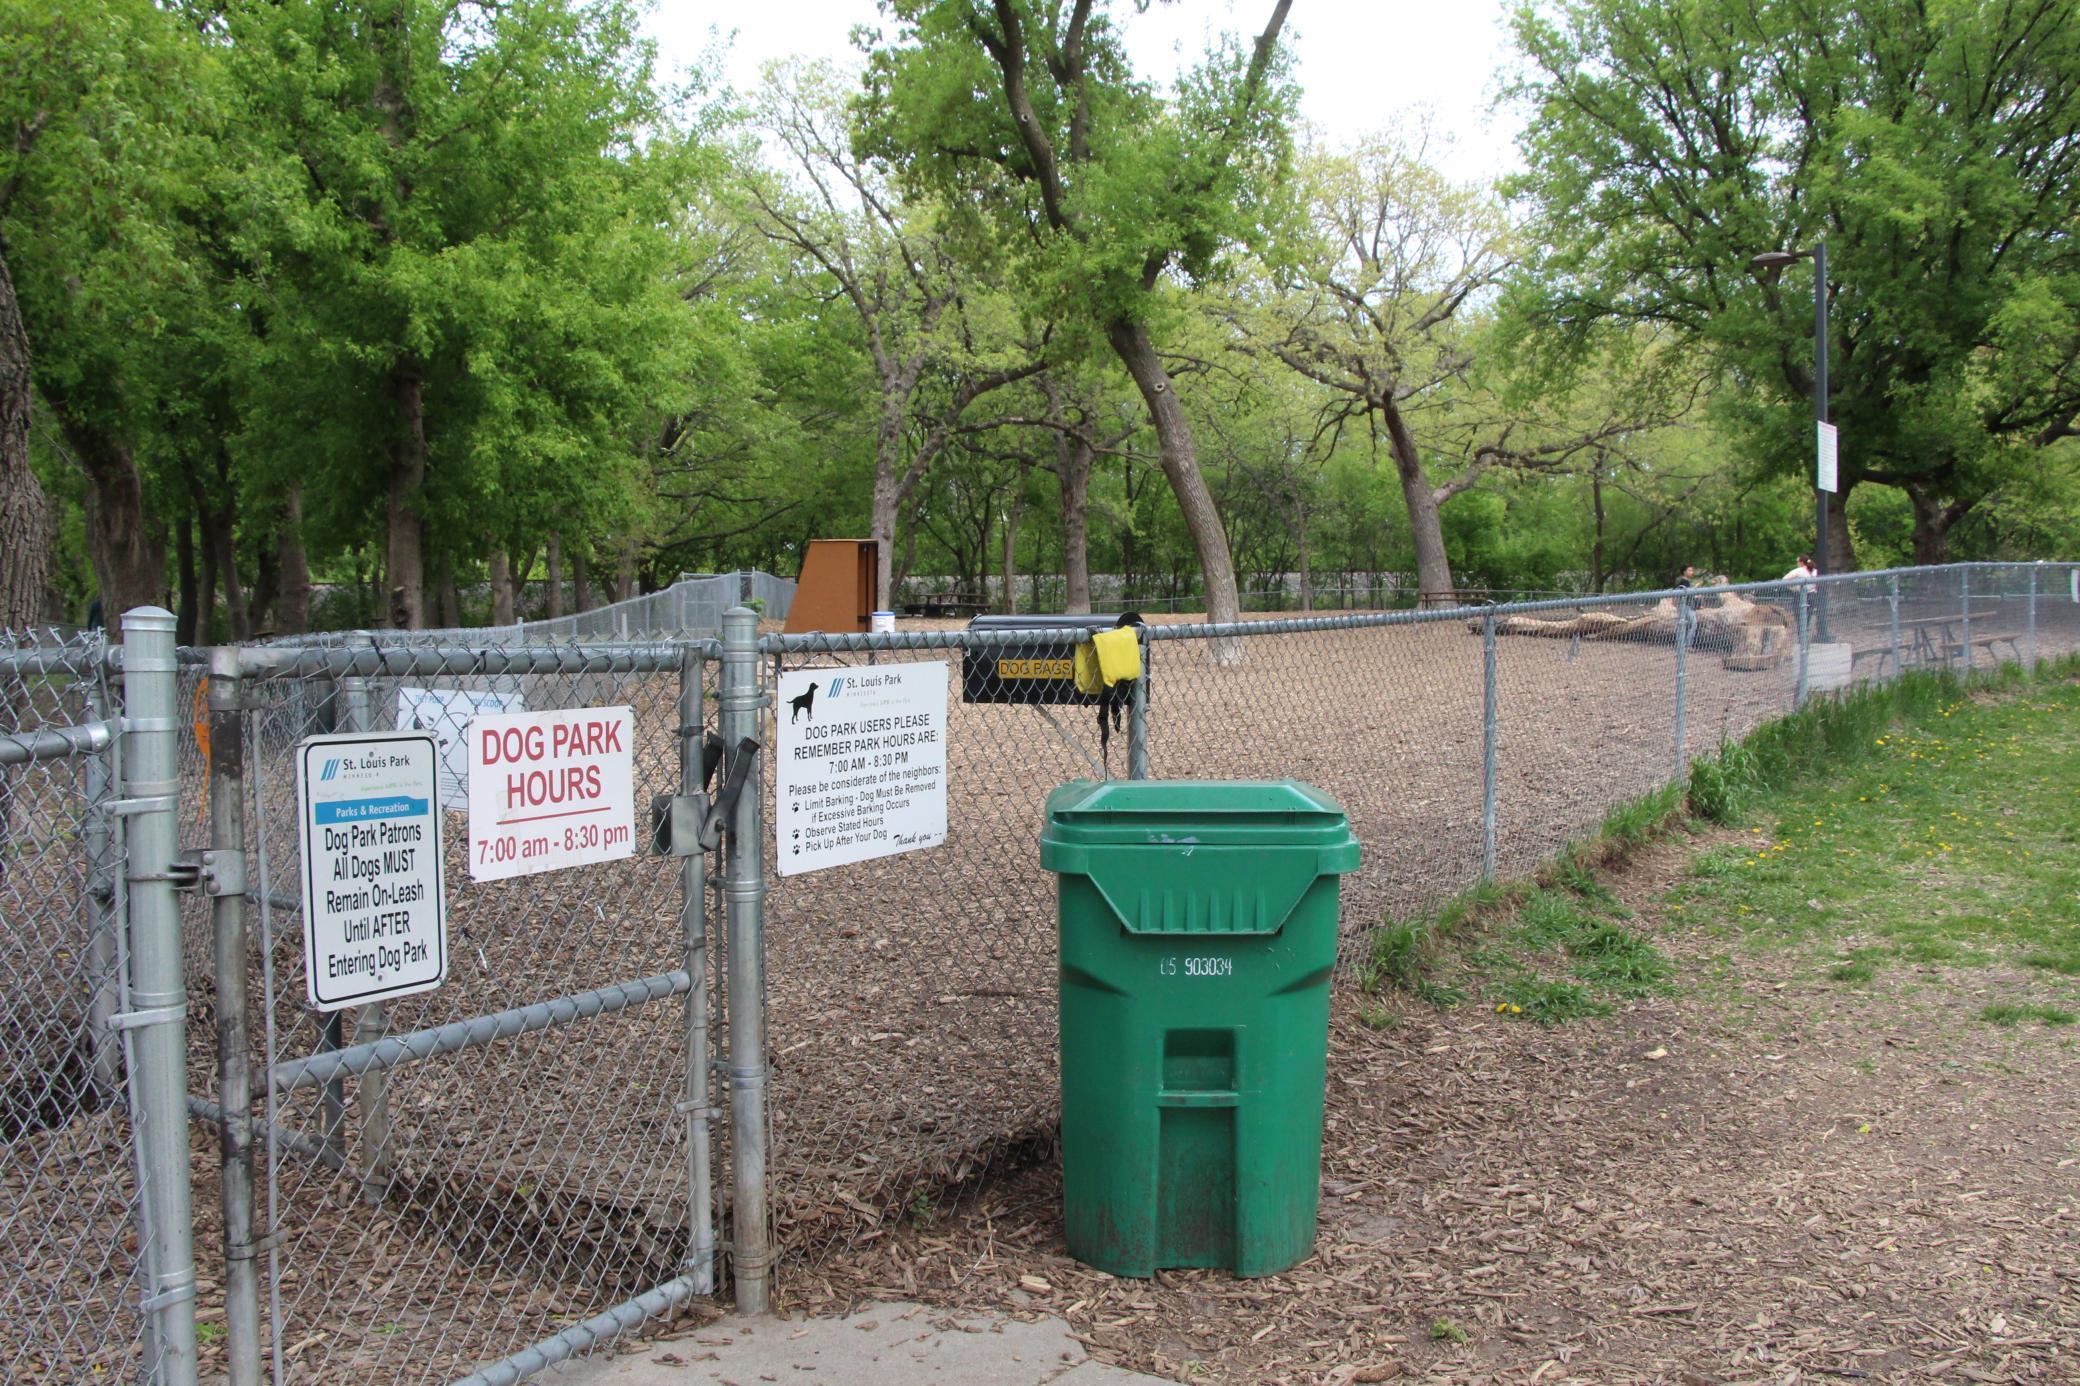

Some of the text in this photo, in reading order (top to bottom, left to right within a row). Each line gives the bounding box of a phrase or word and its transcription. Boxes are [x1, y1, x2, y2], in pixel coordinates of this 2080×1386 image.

[847, 674, 902, 688] St. Louis Park
[1000, 662, 1071, 675] DOG BAGS
[805, 714, 930, 740] DOG PARK USERS PLEASE
[482, 720, 622, 765] DOG PARK
[794, 730, 939, 760] REMEMBER PARK HOURS ARE:
[343, 755, 410, 771] St. Louis Park
[829, 760, 849, 774] 7:00
[851, 757, 866, 770] AM
[874, 754, 892, 767] 8:30
[895, 751, 909, 764] PM
[507, 765, 602, 809] HOURS
[789, 764, 941, 796] Please be considerate of the neighbors:
[805, 798, 824, 811] Limit
[825, 793, 854, 810] Barking
[859, 790, 875, 803] Dog
[876, 787, 893, 799] Must
[894, 784, 904, 795] Be
[905, 780, 936, 794] Removed
[336, 803, 410, 818] Parks & Recreation
[811, 798, 910, 823] if Excessive Barking Occurs
[325, 822, 421, 856] Dog Park Patrons
[805, 830, 888, 852] Pick Up After Your Dog
[806, 816, 884, 838] Observe Stated Hours
[894, 834, 917, 847] Thank
[918, 832, 931, 844] you
[478, 835, 516, 865] 7:00
[522, 835, 548, 858] am
[565, 824, 599, 852] 8:30
[603, 824, 628, 850] pm
[334, 848, 416, 883] All Dogs MUST
[327, 879, 424, 914] Remain On-Leash
[344, 911, 411, 943] Until AFTER
[328, 939, 428, 978] Entering Dog Park
[1185, 957, 1232, 975] 903034
